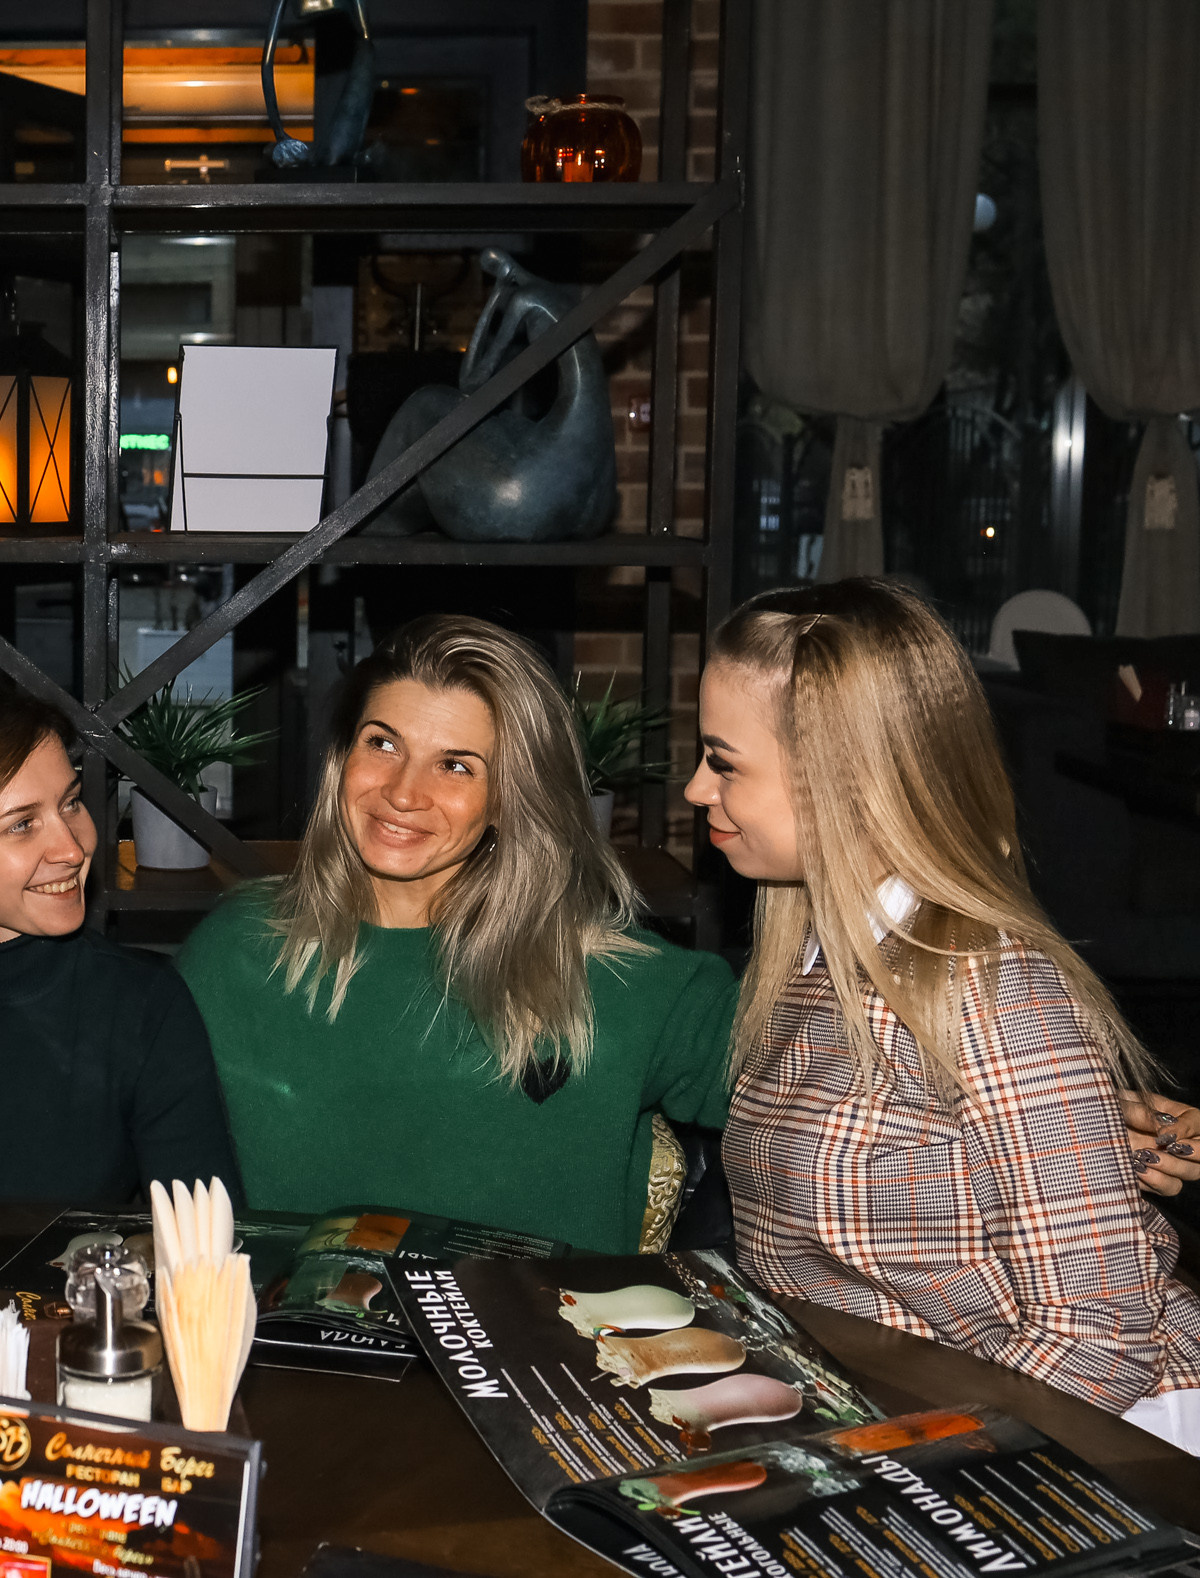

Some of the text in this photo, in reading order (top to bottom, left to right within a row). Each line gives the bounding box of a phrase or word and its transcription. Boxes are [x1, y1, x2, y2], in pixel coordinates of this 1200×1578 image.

[404, 1270, 509, 1398] МОЛОЧНЫЕ
[433, 1269, 494, 1349] КОКТЕЙЛИ
[19, 1480, 179, 1528] HALLOWEEN
[65, 1463, 192, 1495] РЕСТОРАН БАР
[861, 1455, 1028, 1573] ЛИМОНАДЫ
